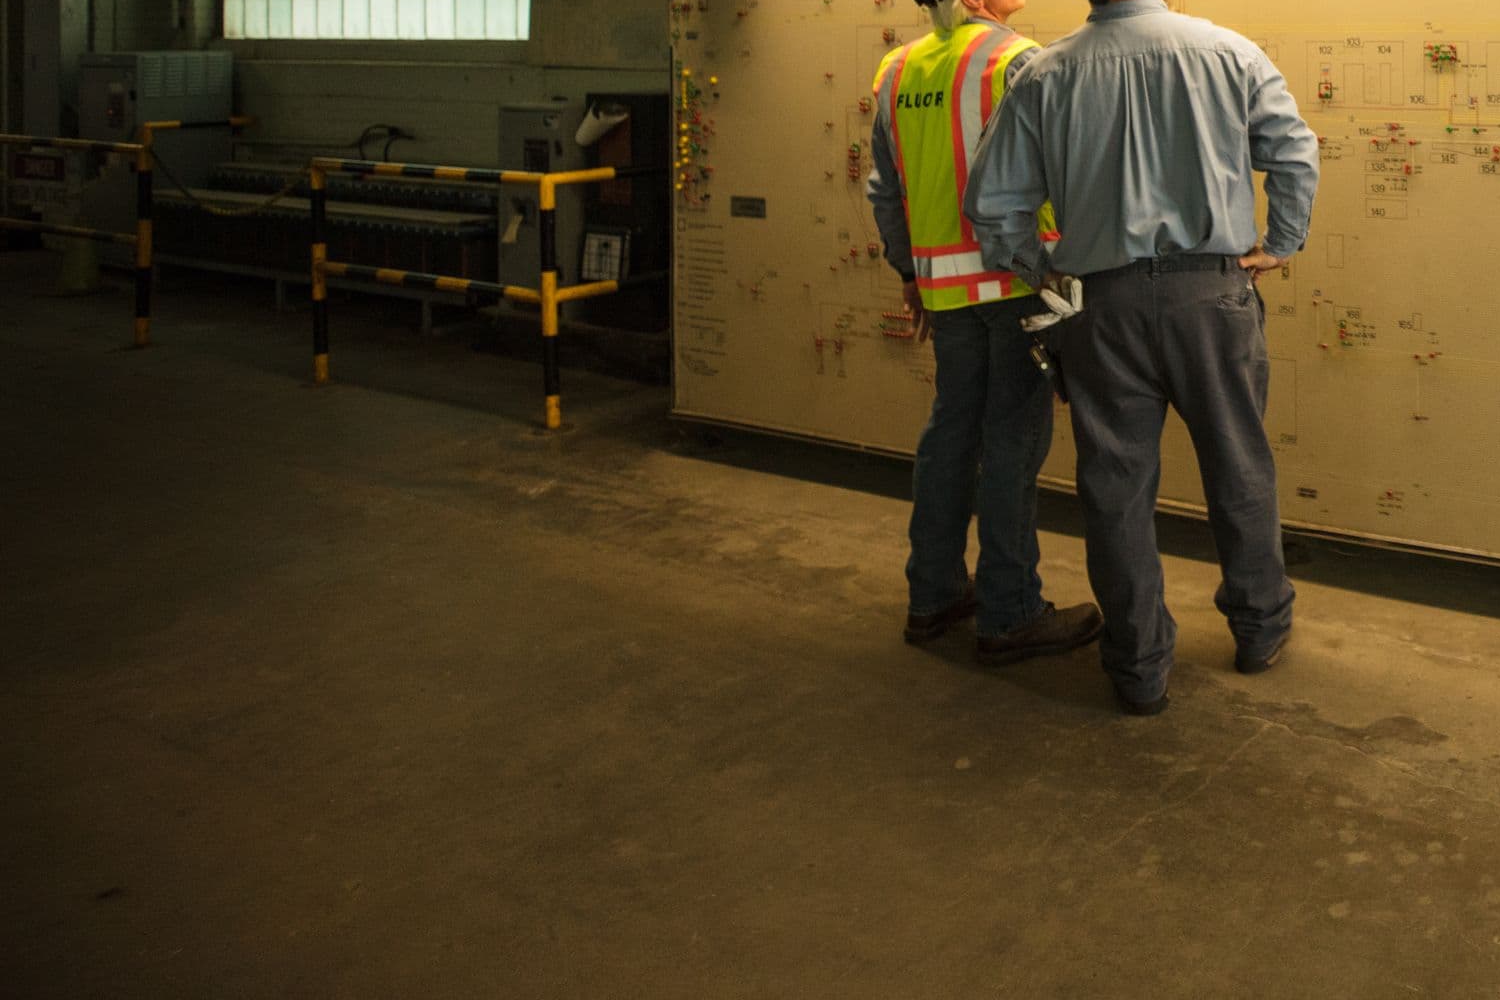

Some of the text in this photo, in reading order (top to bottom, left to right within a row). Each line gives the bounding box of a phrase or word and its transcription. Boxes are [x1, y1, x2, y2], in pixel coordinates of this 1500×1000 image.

[1318, 45, 1333, 55] 102
[1377, 45, 1392, 55] 104
[896, 91, 945, 109] FLUOR
[1409, 94, 1425, 105] 106
[1370, 184, 1386, 194] 139
[1370, 208, 1386, 218] 140
